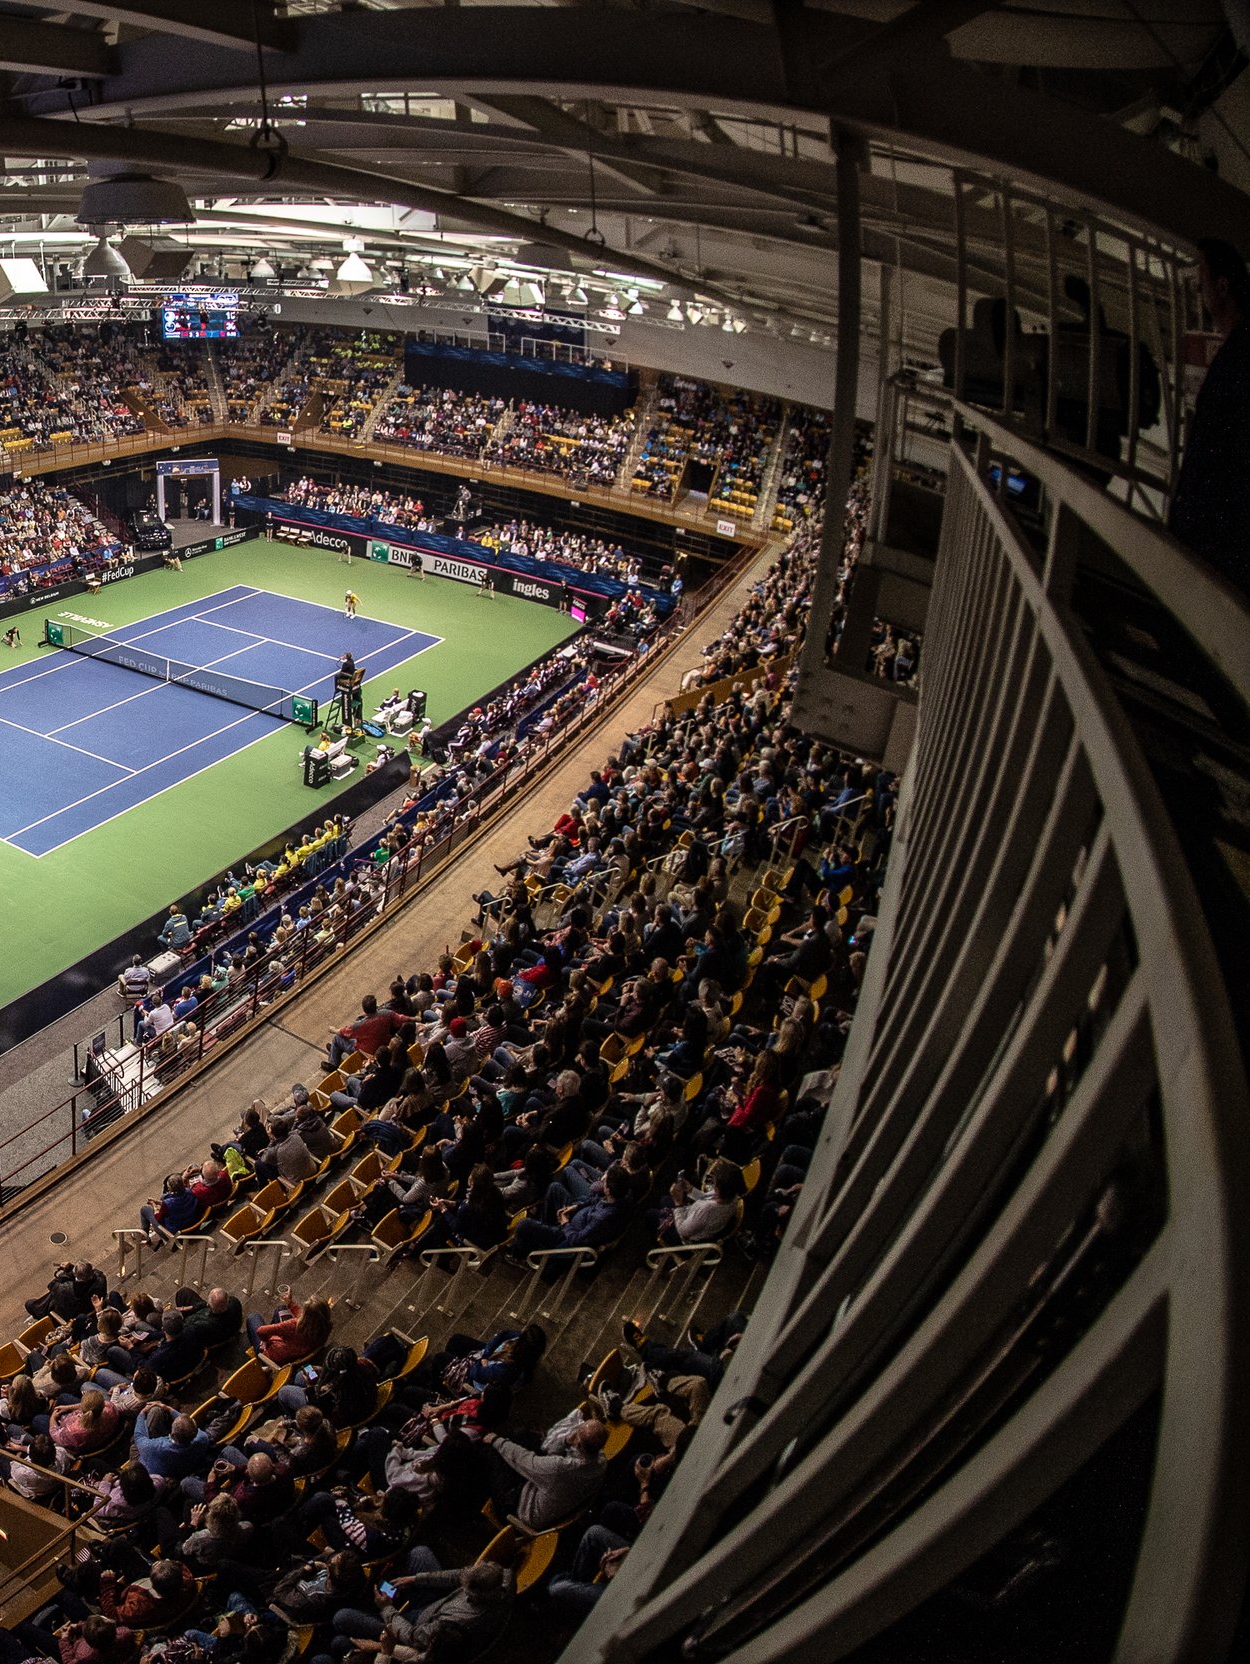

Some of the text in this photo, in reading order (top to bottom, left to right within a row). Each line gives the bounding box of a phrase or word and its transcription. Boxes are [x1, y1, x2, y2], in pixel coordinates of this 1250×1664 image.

[718, 524, 734, 534] EXIT
[101, 566, 134, 583] #FedCup
[434, 559, 485, 583] PARIBAS
[512, 578, 550, 600] ingles
[118, 655, 137, 667] FED
[138, 662, 158, 674] CUP
[190, 679, 228, 696] PARIBAS
